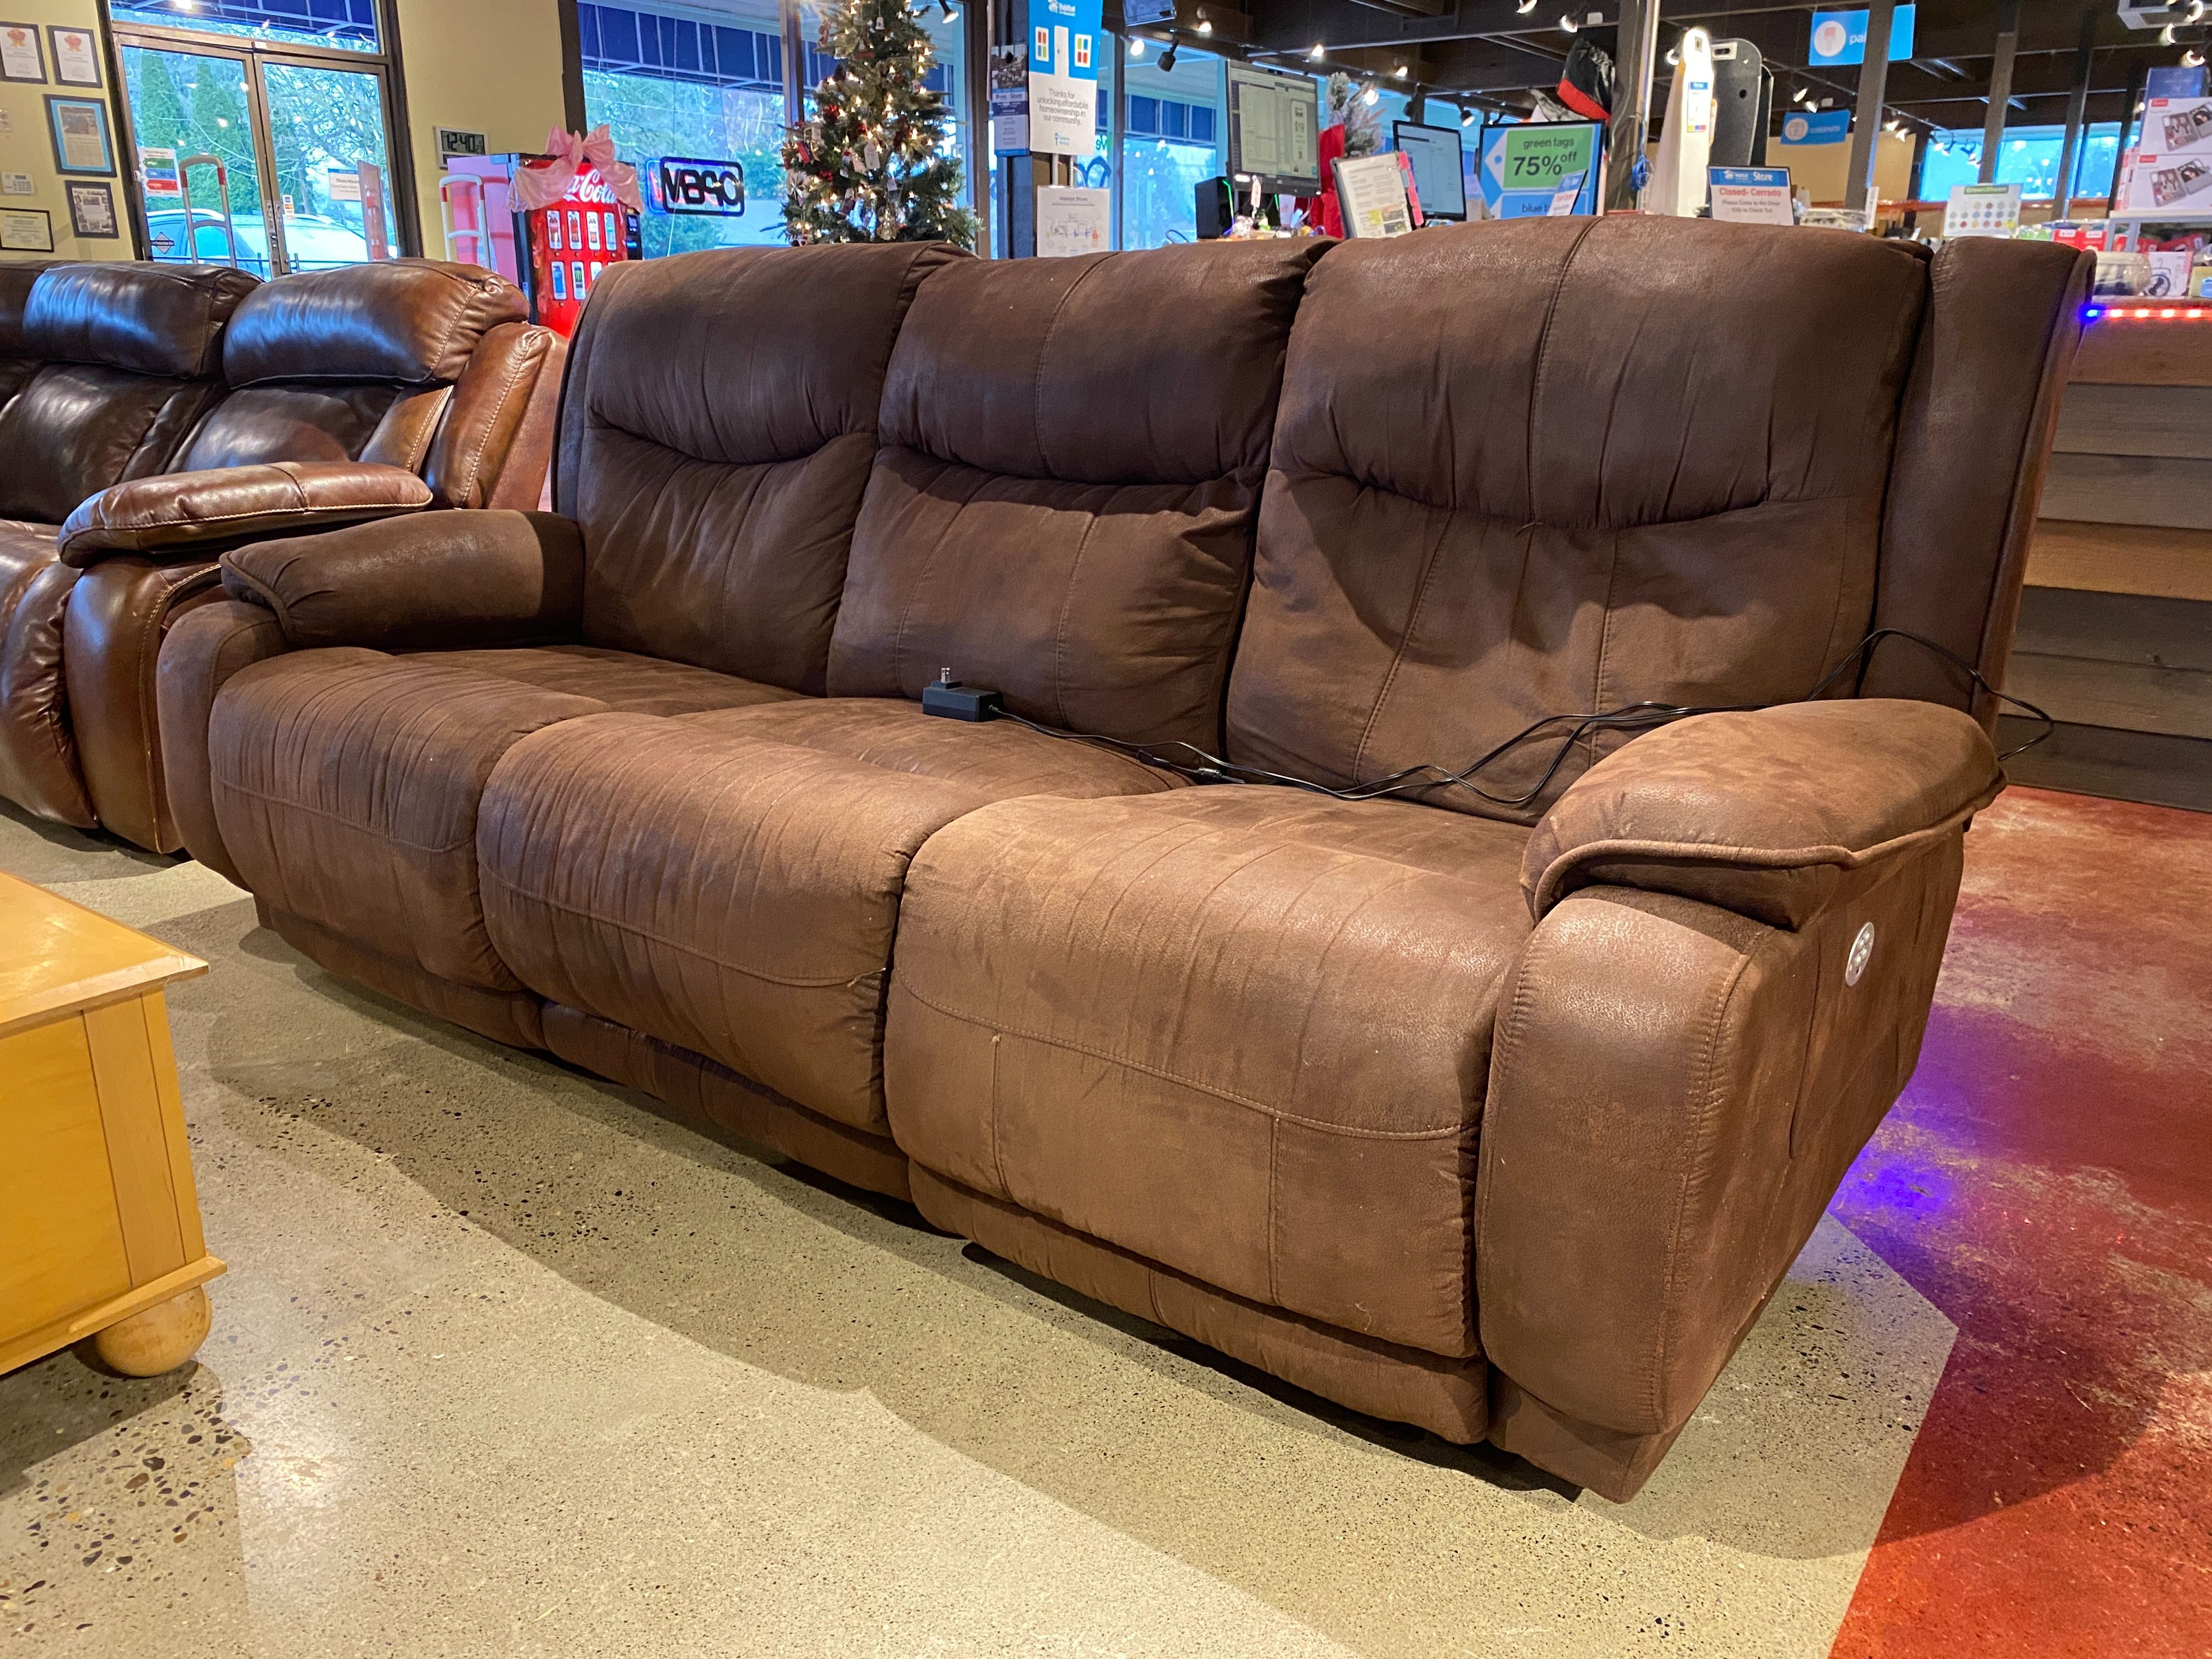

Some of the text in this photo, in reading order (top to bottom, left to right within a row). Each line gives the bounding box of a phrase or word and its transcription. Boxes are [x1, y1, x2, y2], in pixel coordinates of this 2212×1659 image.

[1849, 34, 1867, 46] pai
[1048, 88, 1075, 99] Thanks for
[1036, 97, 1088, 110] unlocking affordable
[1039, 104, 1080, 118] homeownership
[447, 132, 476, 153] 12:40
[1523, 138, 1575, 149] green tags
[1513, 151, 1577, 176] 75% off
[1752, 171, 1774, 182] Store
[1719, 187, 1781, 197] Closed- Cerrado
[1522, 204, 1543, 213] blue
